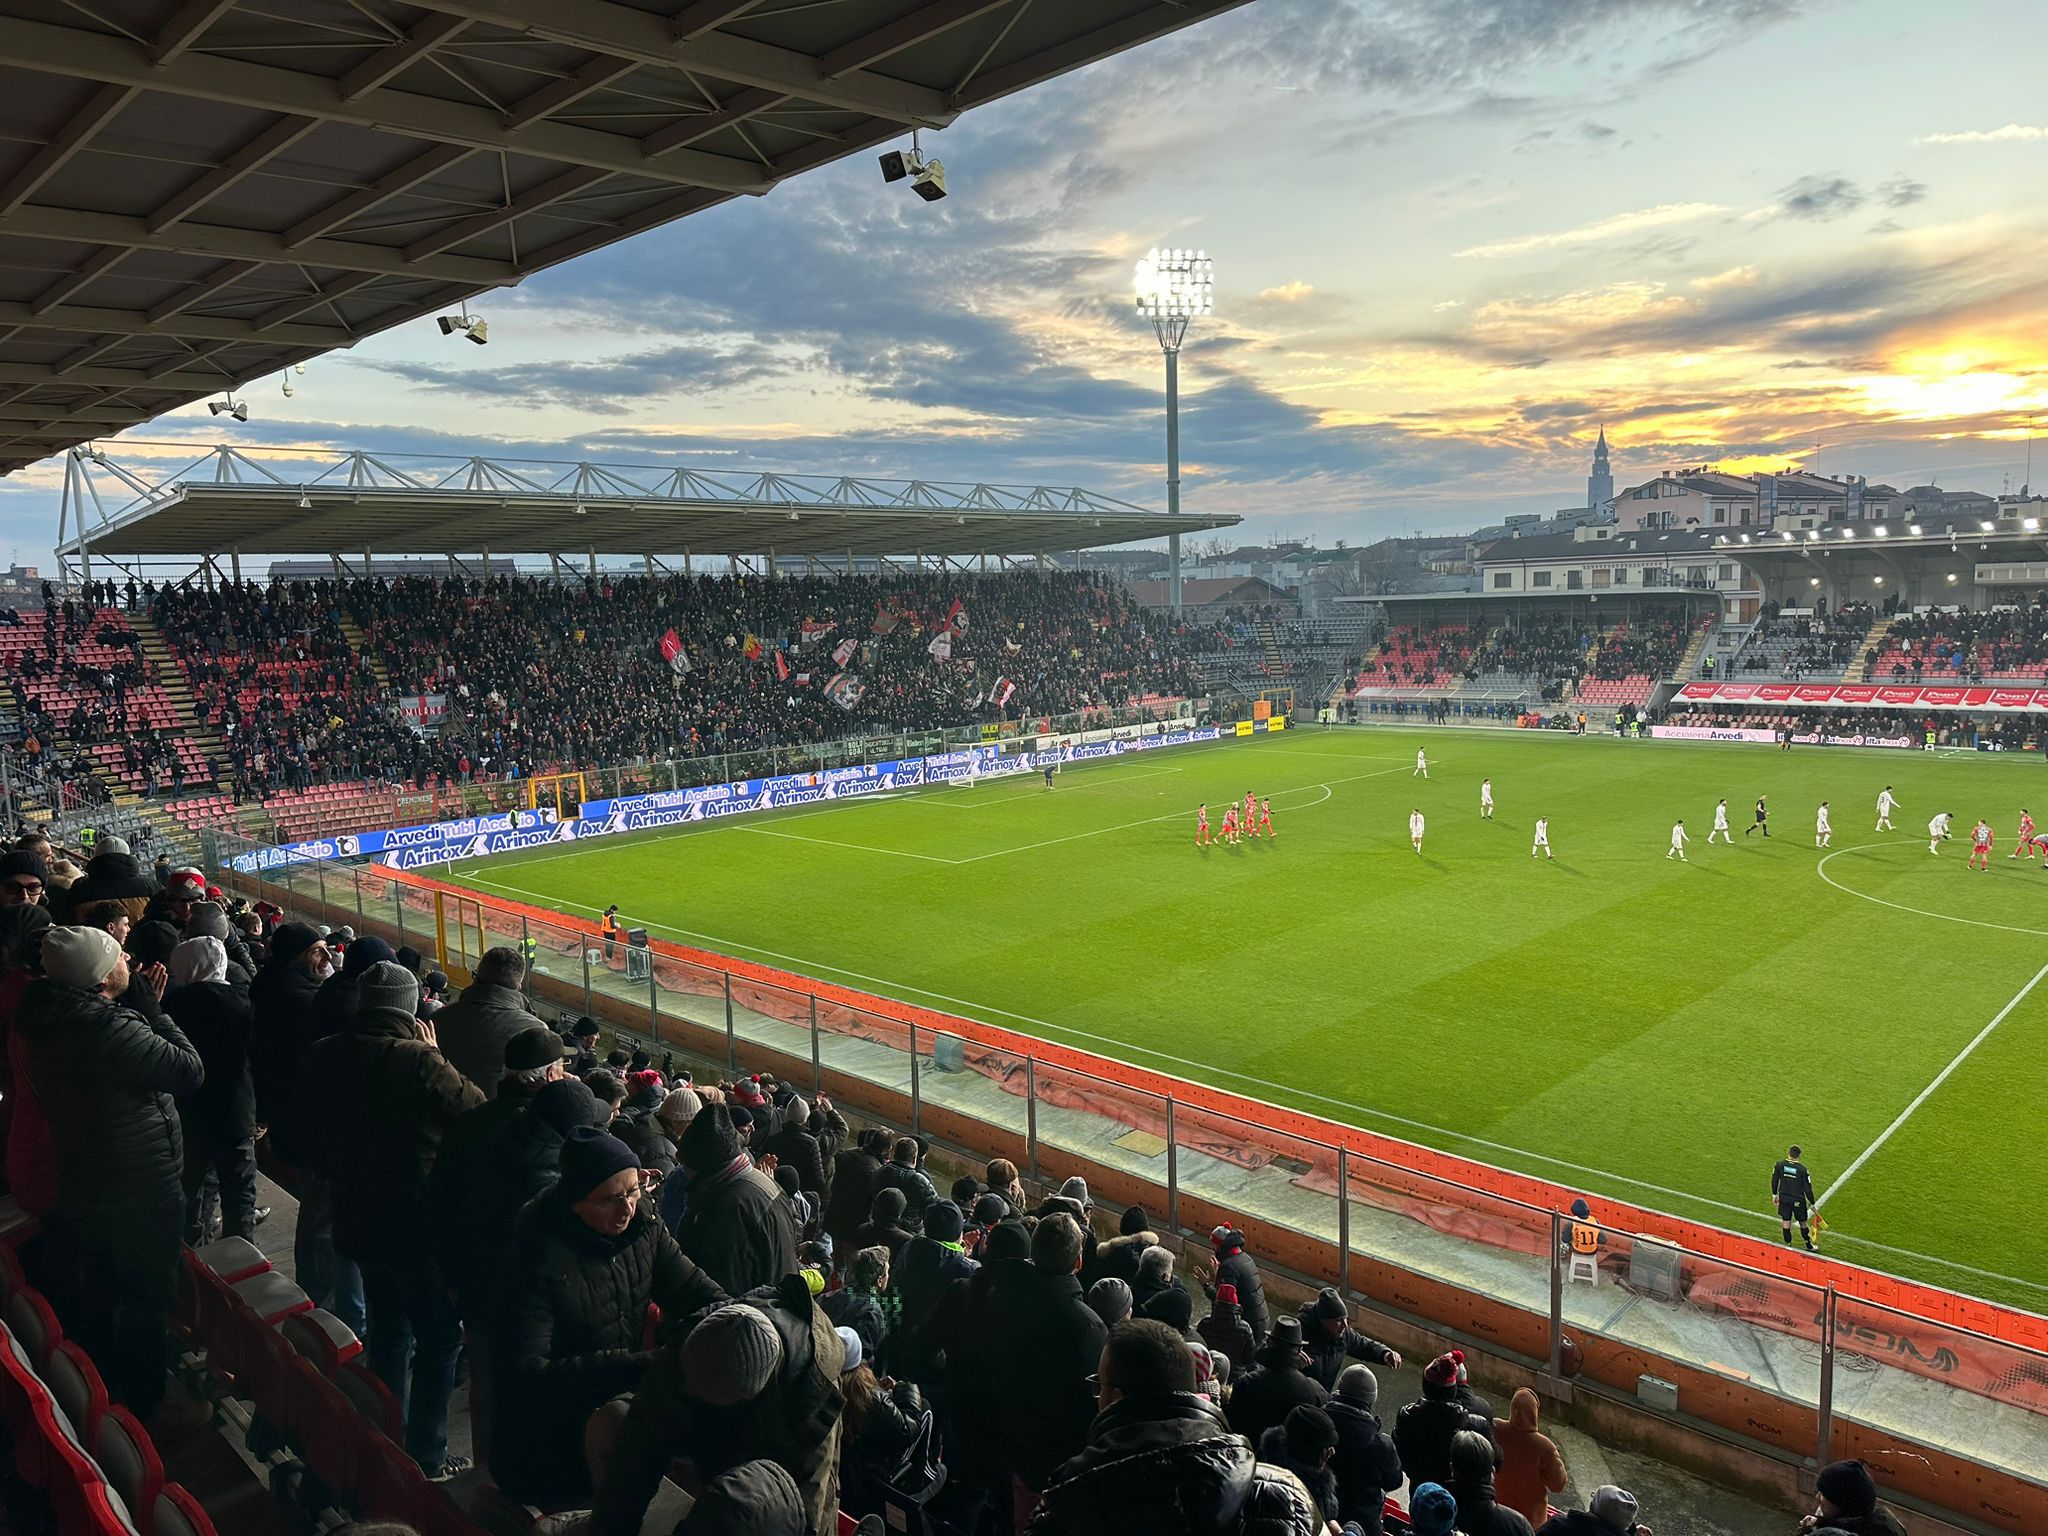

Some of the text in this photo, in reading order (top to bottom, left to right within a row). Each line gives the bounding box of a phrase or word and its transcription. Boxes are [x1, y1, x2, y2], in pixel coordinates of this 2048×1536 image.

[1710, 731, 1744, 741] Arvedi
[762, 774, 800, 792] Arvedi
[824, 768, 862, 784] Acciaio
[403, 843, 462, 869] Arinox
[492, 831, 550, 852] Arinox
[630, 811, 682, 829] Arinox
[706, 799, 752, 817] Arinox
[775, 789, 818, 807] Arinox
[838, 780, 878, 797] Arinox
[930, 766, 966, 782] Arinox
[982, 757, 1015, 773] Arinox
[1075, 744, 1105, 759] Arinox
[609, 786, 730, 814] Arvedi Tubi Acciaio
[384, 825, 440, 848] Arvedi
[441, 820, 475, 838] Tubi
[1580, 1231, 1595, 1245] 11
